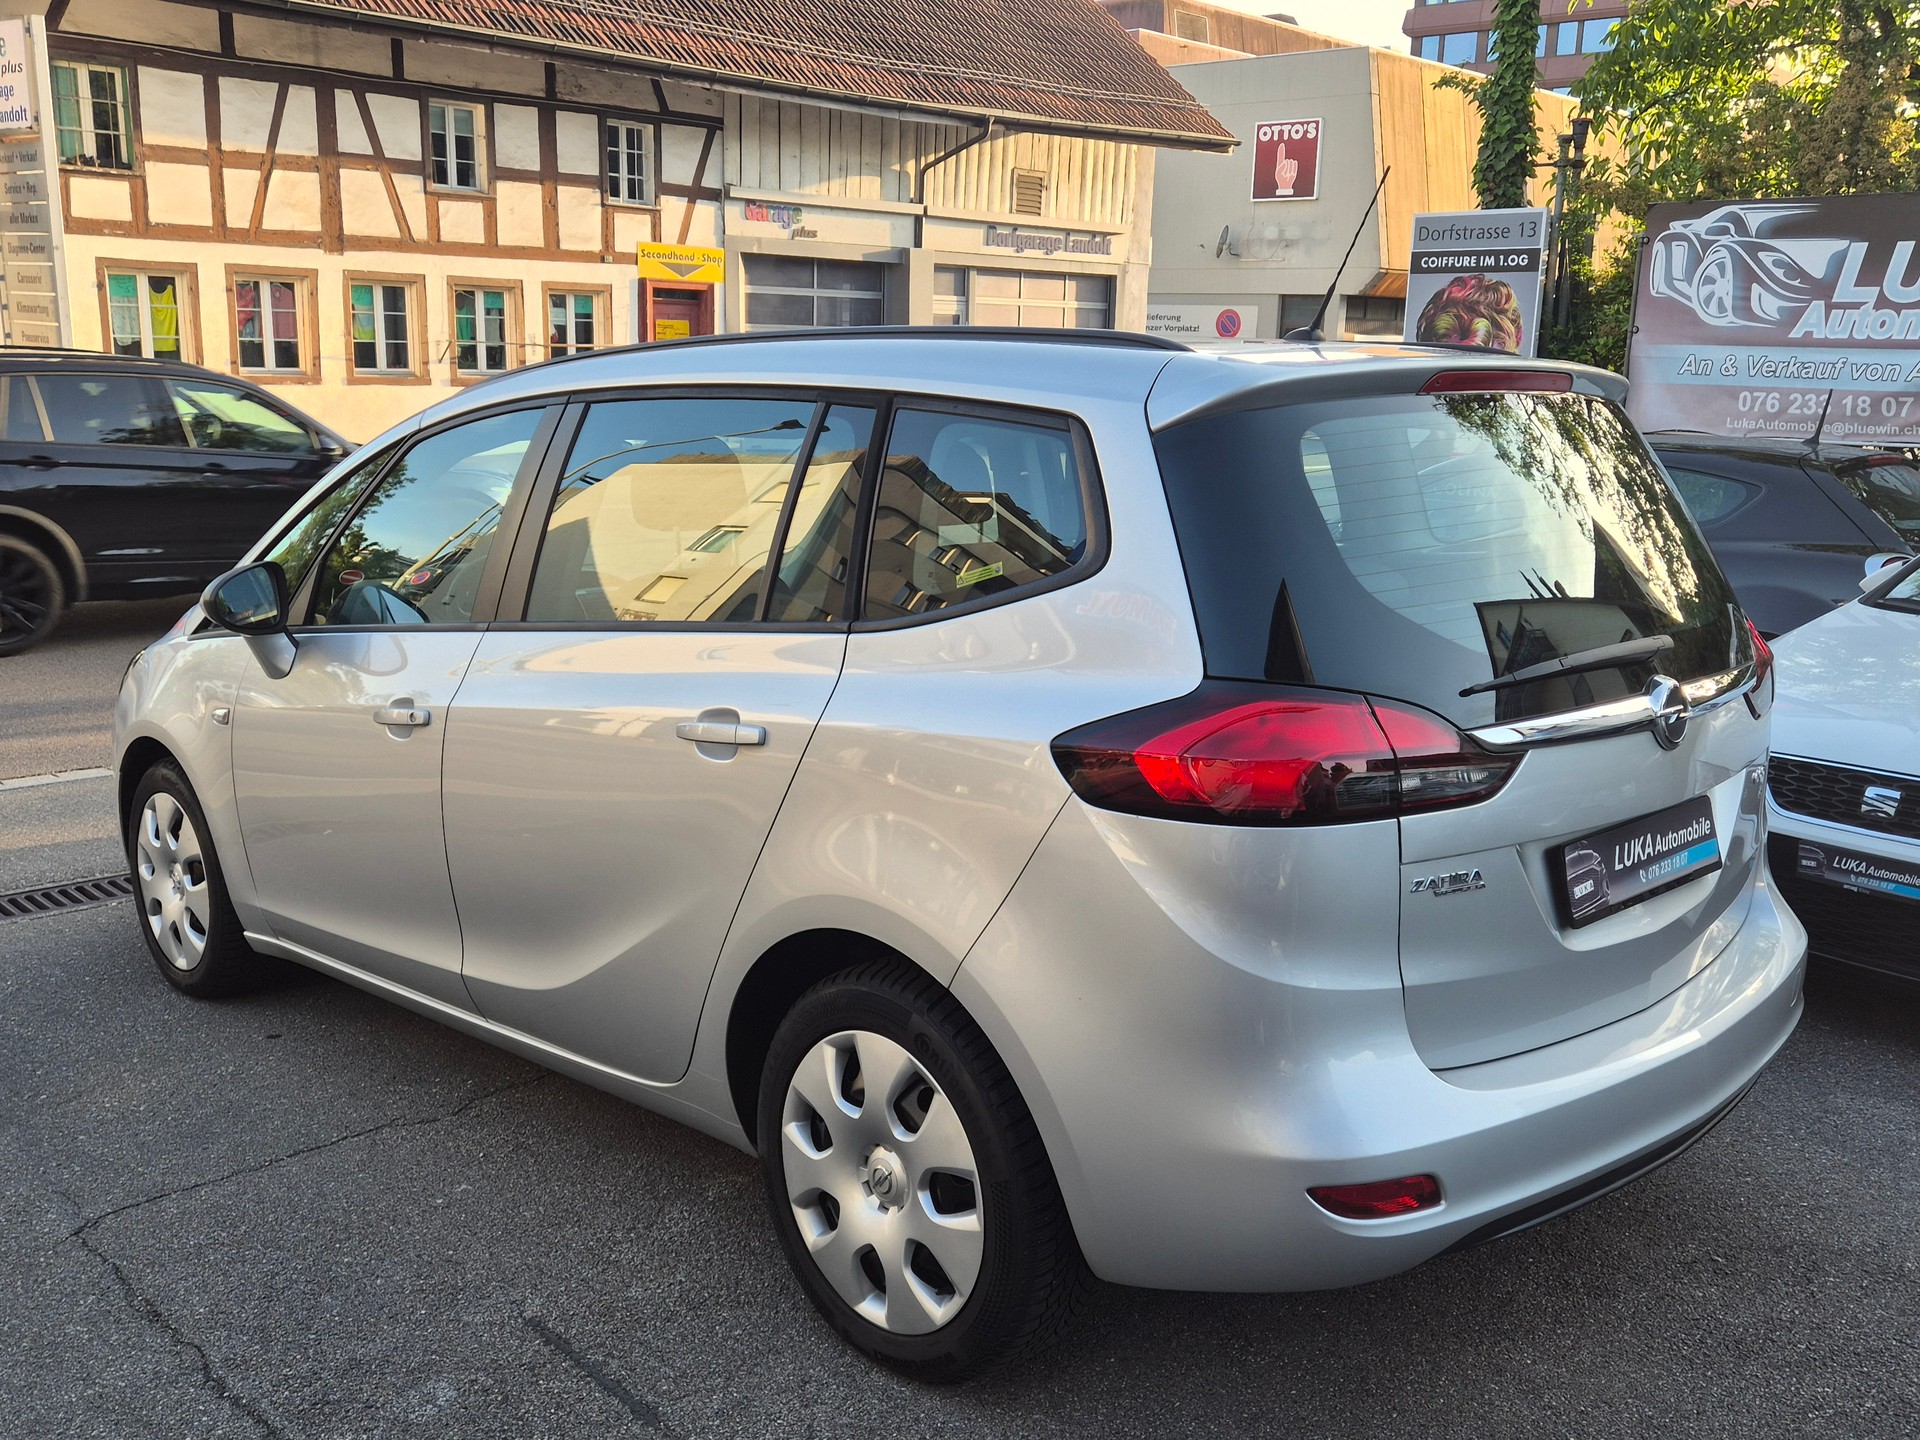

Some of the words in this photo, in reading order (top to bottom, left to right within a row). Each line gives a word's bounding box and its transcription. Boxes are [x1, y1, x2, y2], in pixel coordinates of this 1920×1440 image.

[1, 59, 23, 78] plus
[1258, 122, 1318, 142] OTTO'S
[0, 151, 14, 163] nkauf
[4, 182, 22, 194] Service
[744, 200, 803, 230] Garage
[791, 226, 818, 240] plus
[986, 225, 1063, 255] Dorfgarage
[1065, 231, 1112, 255] Landolt
[1418, 225, 1511, 243] Dorfstrasse
[1518, 221, 1538, 239] 13
[640, 248, 695, 262] Secondhand
[701, 253, 723, 267] Shop
[1421, 255, 1478, 268] COIFFURE
[1480, 255, 1496, 267] IM
[1498, 254, 1529, 267] 1.OG
[1831, 240, 1920, 303] LU
[16, 301, 49, 317] Klimawartung
[1164, 324, 1200, 333] Vorplatz!
[1677, 354, 1713, 376] An
[1720, 355, 1738, 377] &
[1747, 355, 1849, 380] Verkauf
[1851, 363, 1902, 382] von
[1738, 391, 1780, 413] 076
[1787, 393, 1832, 415] 233
[1842, 395, 1872, 417] 18
[1881, 396, 1915, 418] 07
[1726, 417, 1920, 436] LukaAutomobie@bluewin.ch
[1614, 833, 1654, 871] LUKA
[1655, 817, 1711, 855] Automobile
[1648, 866, 1660, 880] 076
[1660, 861, 1672, 876] 233
[1673, 857, 1680, 871] 18
[1680, 853, 1688, 867] 07
[1833, 855, 1867, 874] LUKA
[1867, 866, 1920, 887] Automobile
[1574, 881, 1594, 898] LUKA
